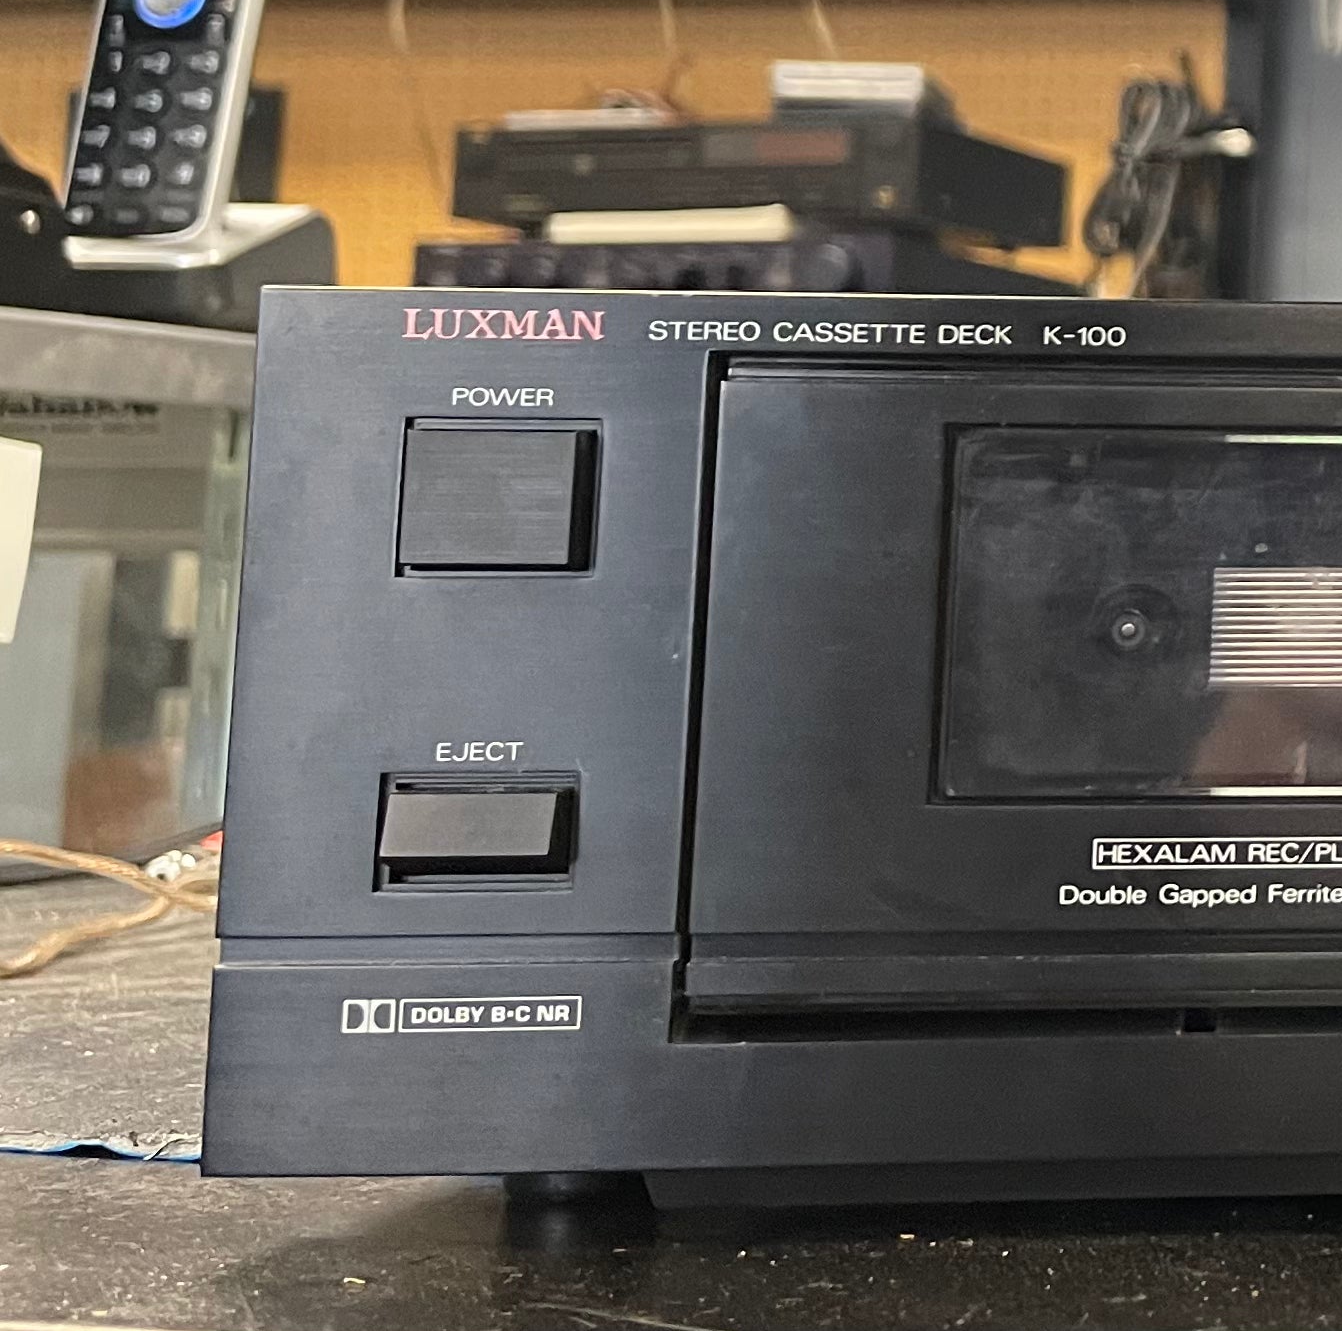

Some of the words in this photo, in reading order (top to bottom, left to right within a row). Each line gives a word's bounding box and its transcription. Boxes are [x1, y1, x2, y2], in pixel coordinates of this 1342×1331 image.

[401, 308, 605, 341] LUXMAN
[648, 320, 761, 342] STEREO
[772, 321, 926, 344] CASSETTE
[937, 324, 1012, 345] DECK
[1043, 325, 1127, 347] K-100
[451, 387, 555, 407] POWER
[435, 741, 524, 762] EJECT
[1098, 843, 1236, 863] HEXALAM
[1059, 884, 1148, 905] Double
[1158, 883, 1257, 909] Gapped
[410, 1005, 485, 1024] DOLBY
[536, 1004, 570, 1022] NR
